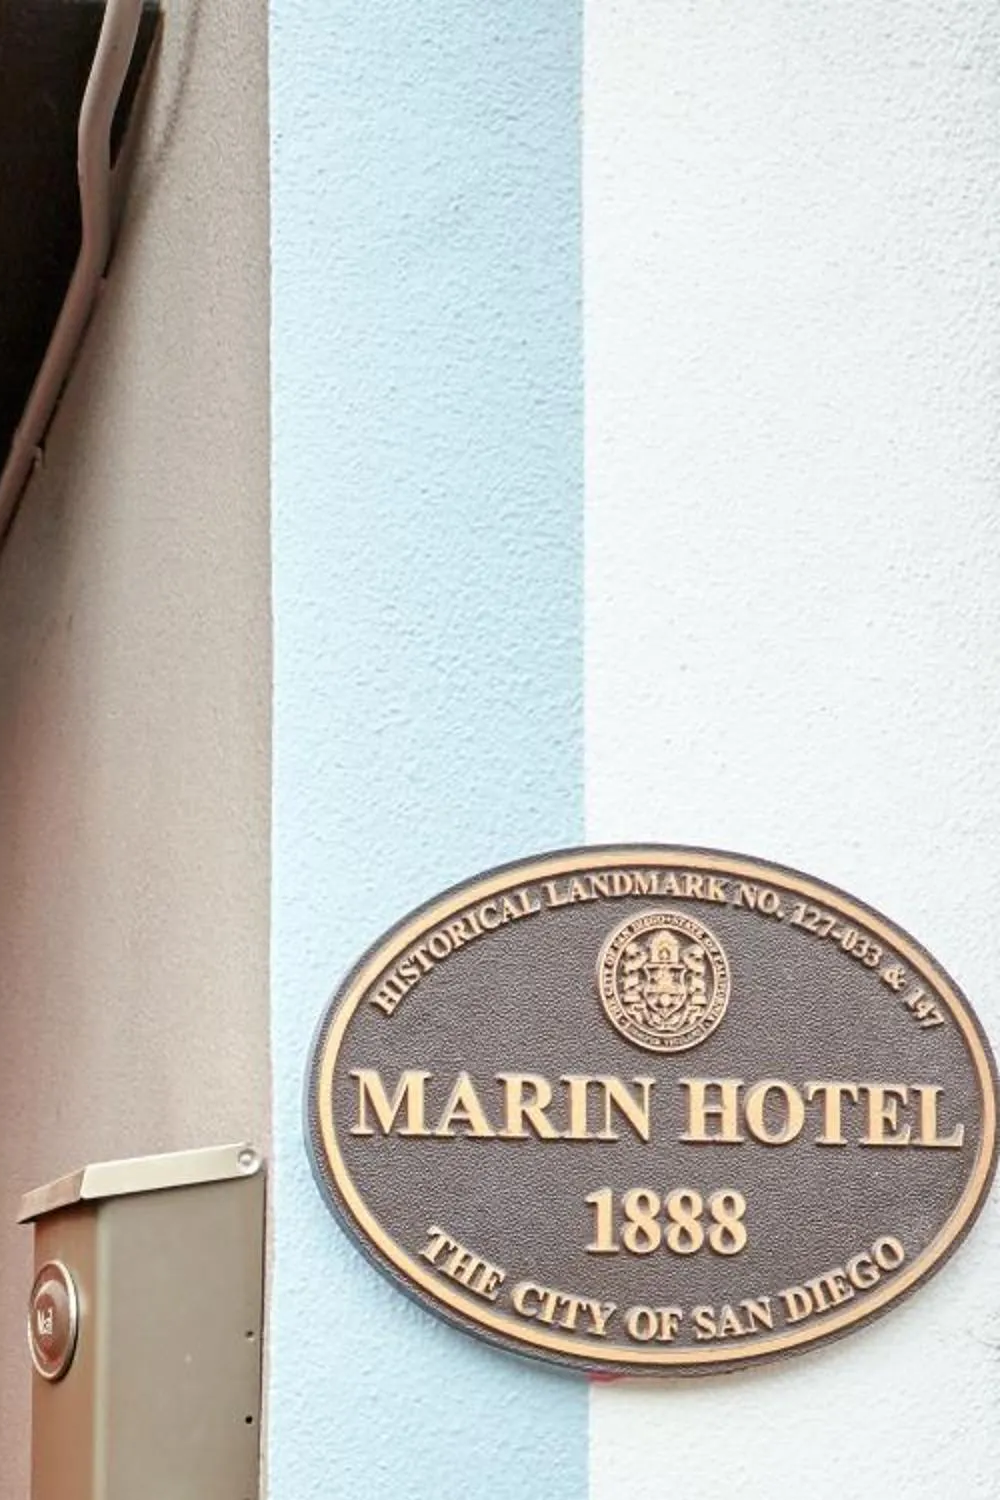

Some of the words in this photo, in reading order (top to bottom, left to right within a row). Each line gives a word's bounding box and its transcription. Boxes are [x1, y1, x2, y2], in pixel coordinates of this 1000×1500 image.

[371, 889, 541, 1017] HISTORICAL
[546, 870, 727, 908] LANDMARK
[735, 881, 784, 919] NO.
[790, 903, 883, 968] 127-033
[881, 966, 907, 991] &
[350, 1069, 655, 1145] MARIN
[680, 1077, 964, 1149] HOTEL
[584, 1187, 748, 1257] 1888
[417, 1225, 507, 1301] THE
[511, 1280, 618, 1336] CITY
[626, 1304, 684, 1342] OF
[691, 1299, 775, 1340] SAN
[779, 1235, 906, 1324] DIEGO
